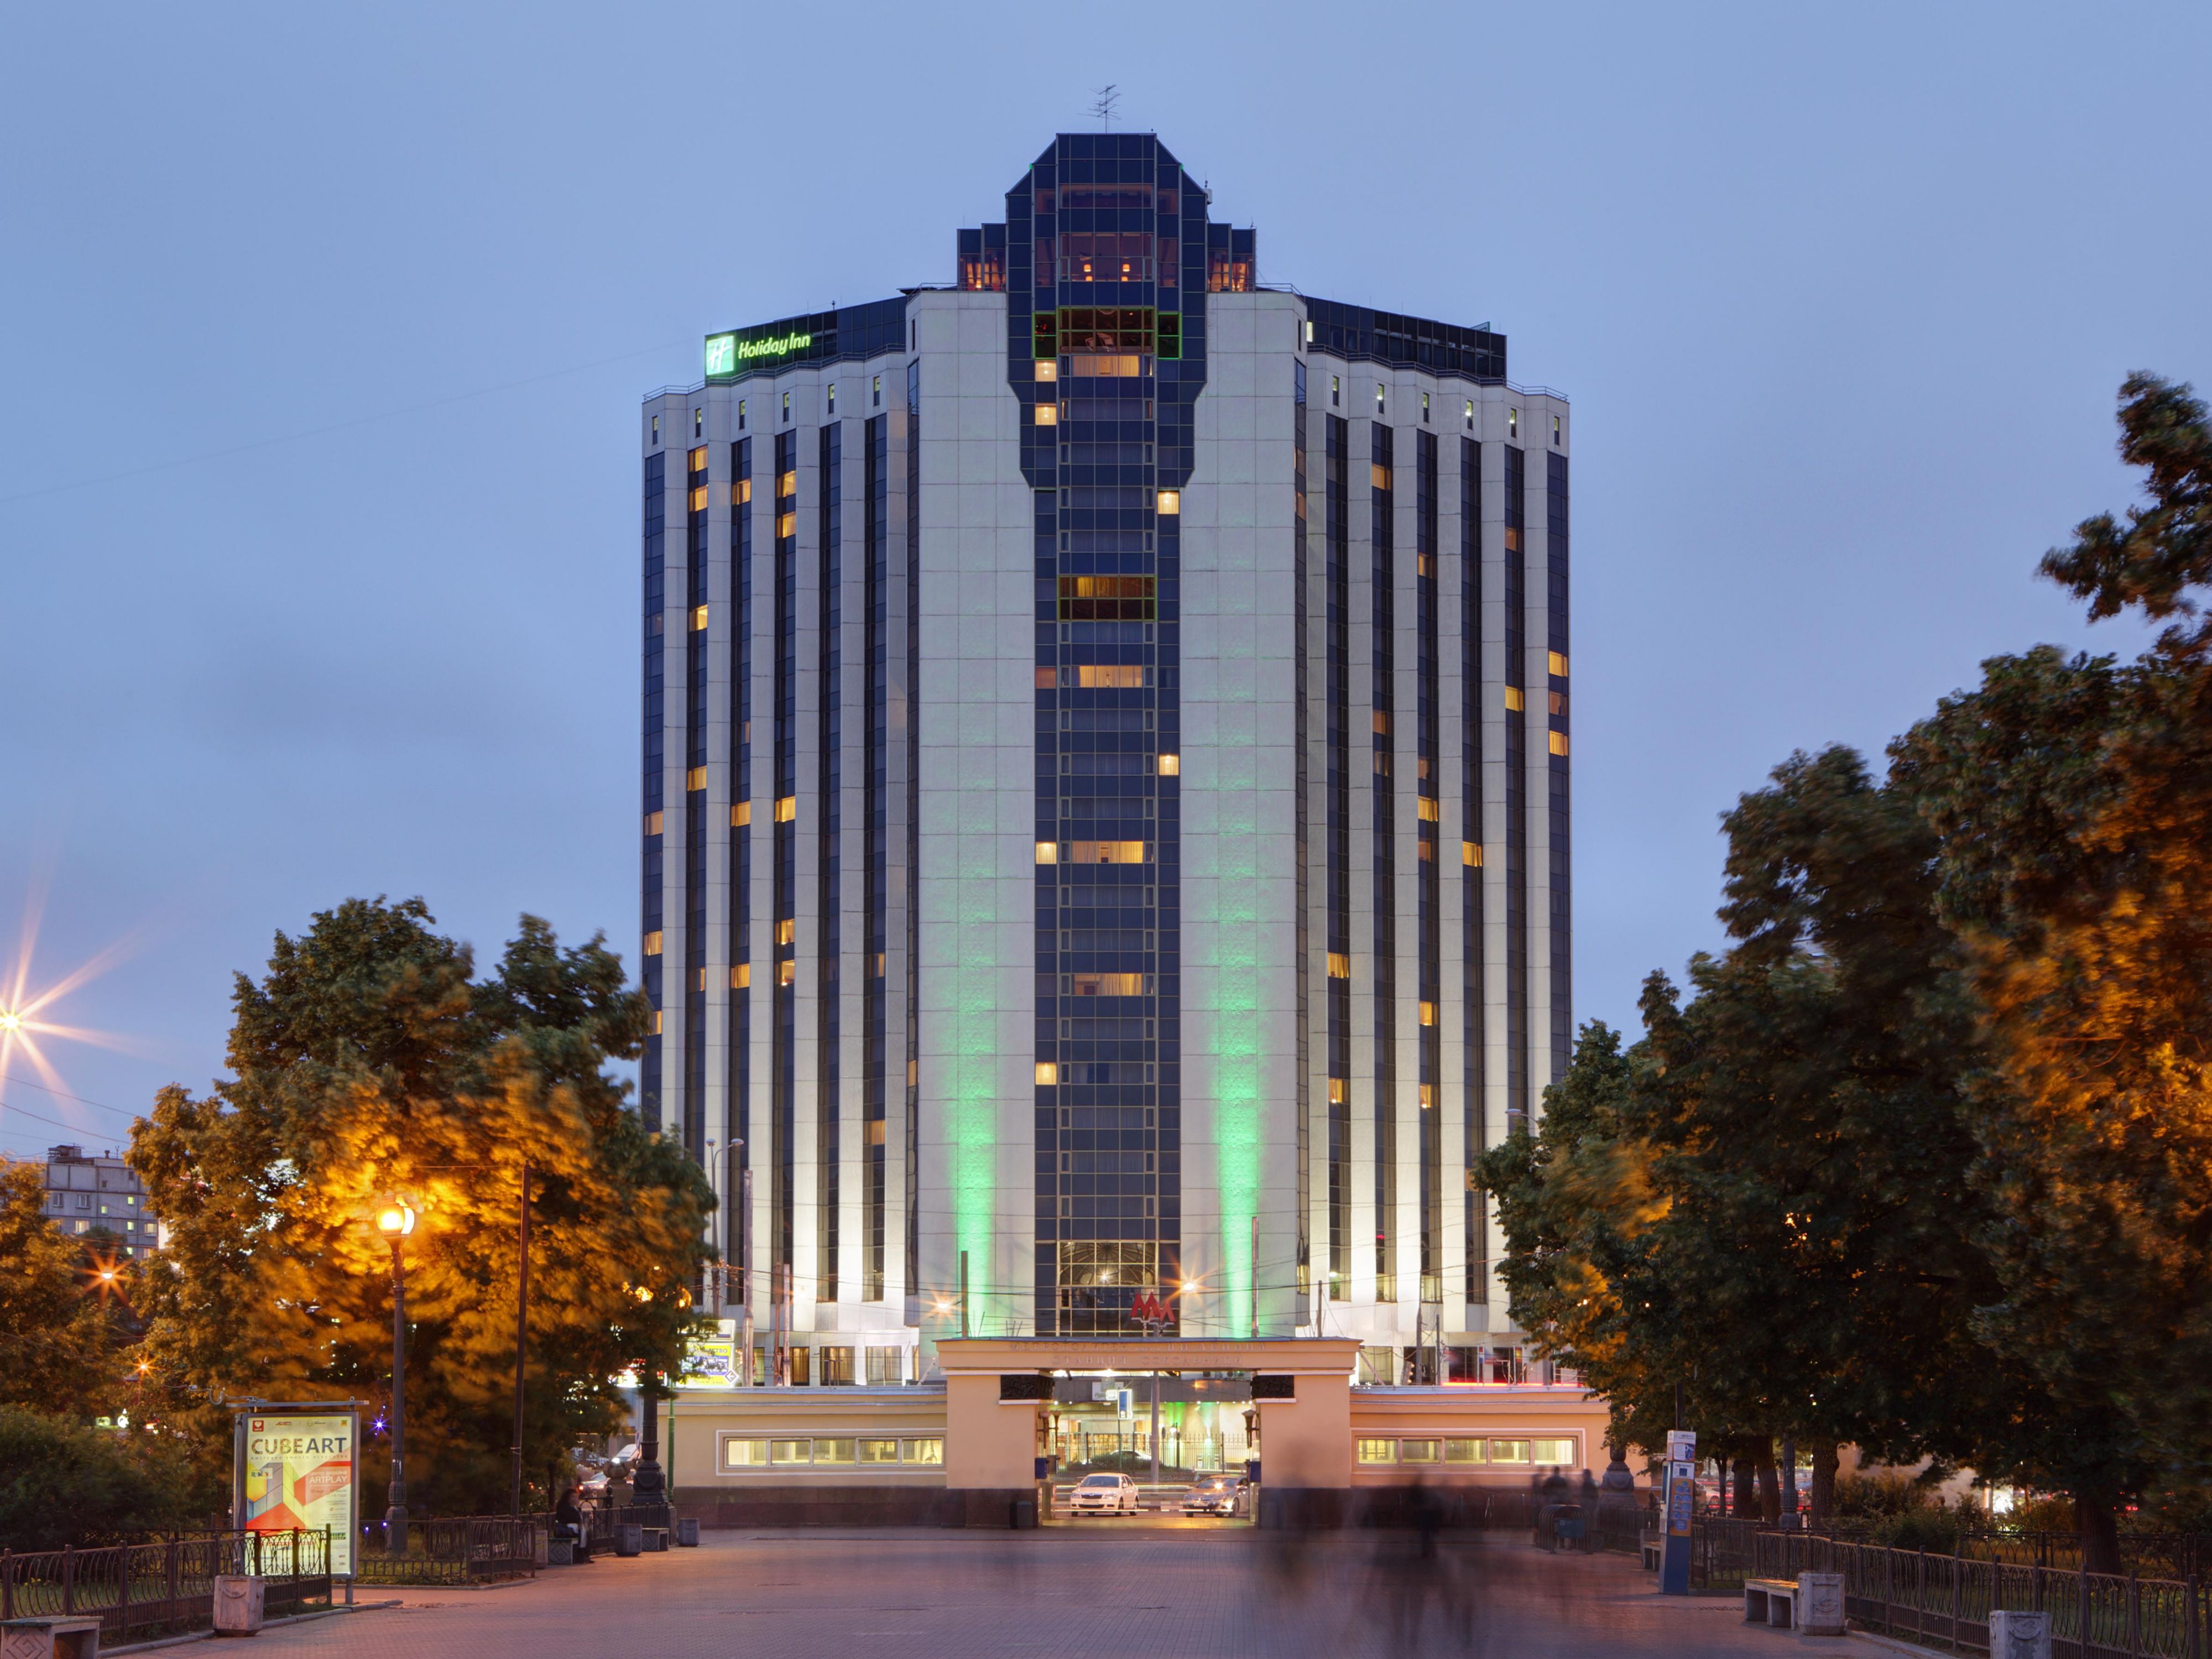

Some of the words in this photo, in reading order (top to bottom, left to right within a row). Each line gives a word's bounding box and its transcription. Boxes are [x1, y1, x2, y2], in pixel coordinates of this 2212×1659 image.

[738, 337, 788, 359] Holiday
[789, 332, 811, 349] Inn
[1010, 1342, 1128, 1350] МЕТРОПОЛИТЕН
[1052, 1355, 1127, 1365] СТАНЦИЯ
[1141, 1356, 1243, 1365] СОКОЛЬНИКИ
